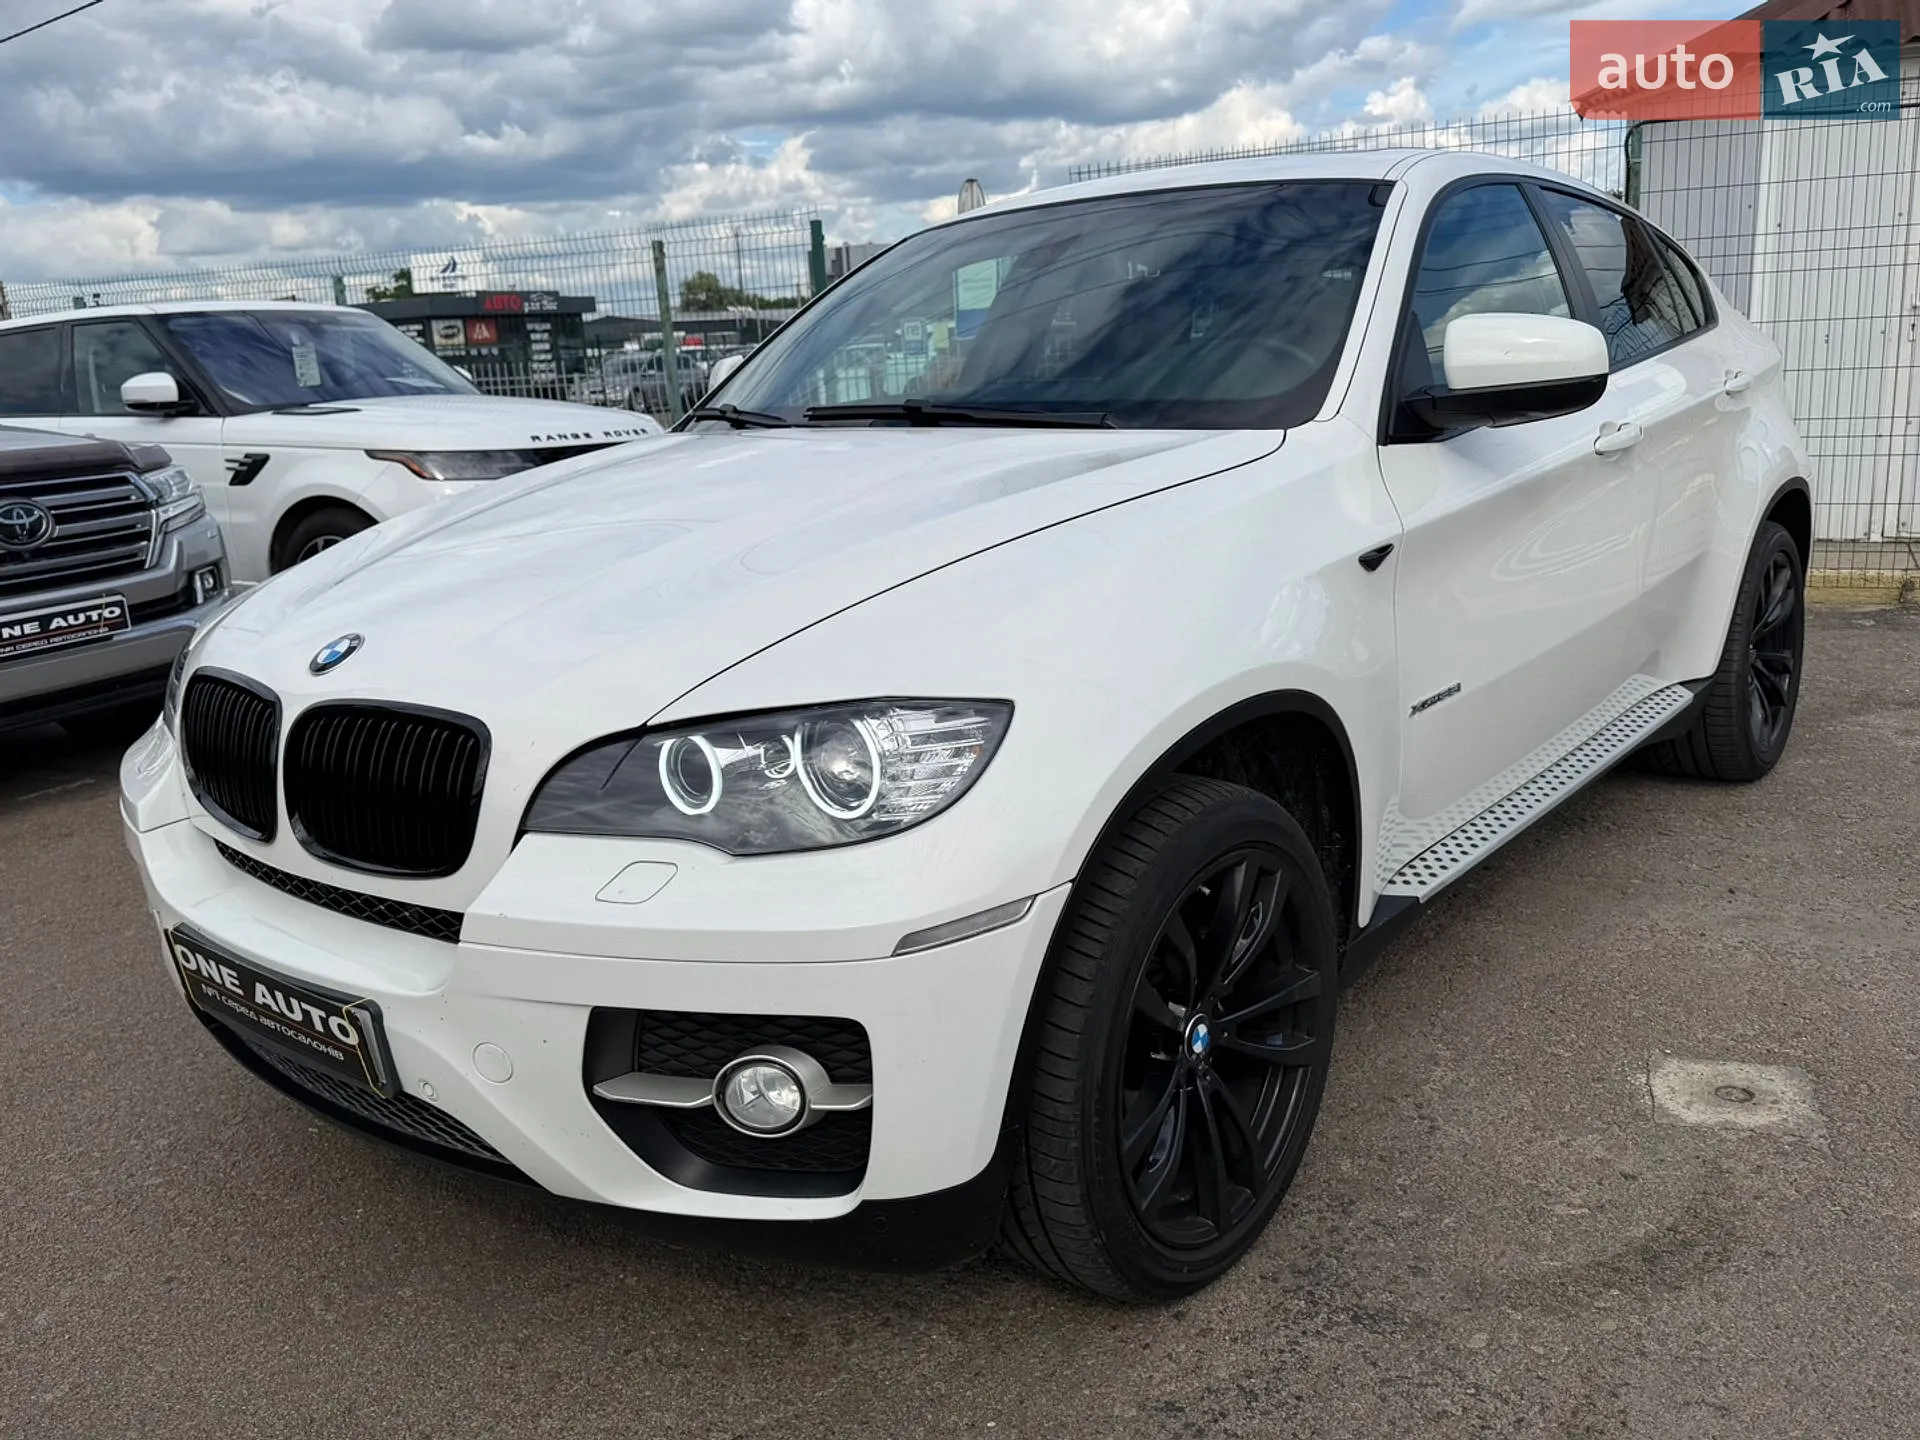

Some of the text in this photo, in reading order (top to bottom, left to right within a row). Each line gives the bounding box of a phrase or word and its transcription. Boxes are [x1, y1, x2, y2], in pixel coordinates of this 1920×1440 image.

[530, 428, 648, 443] RANGE ROVER
[0, 606, 122, 638] NE AUTO
[174, 943, 359, 1045] ONE AUTO
